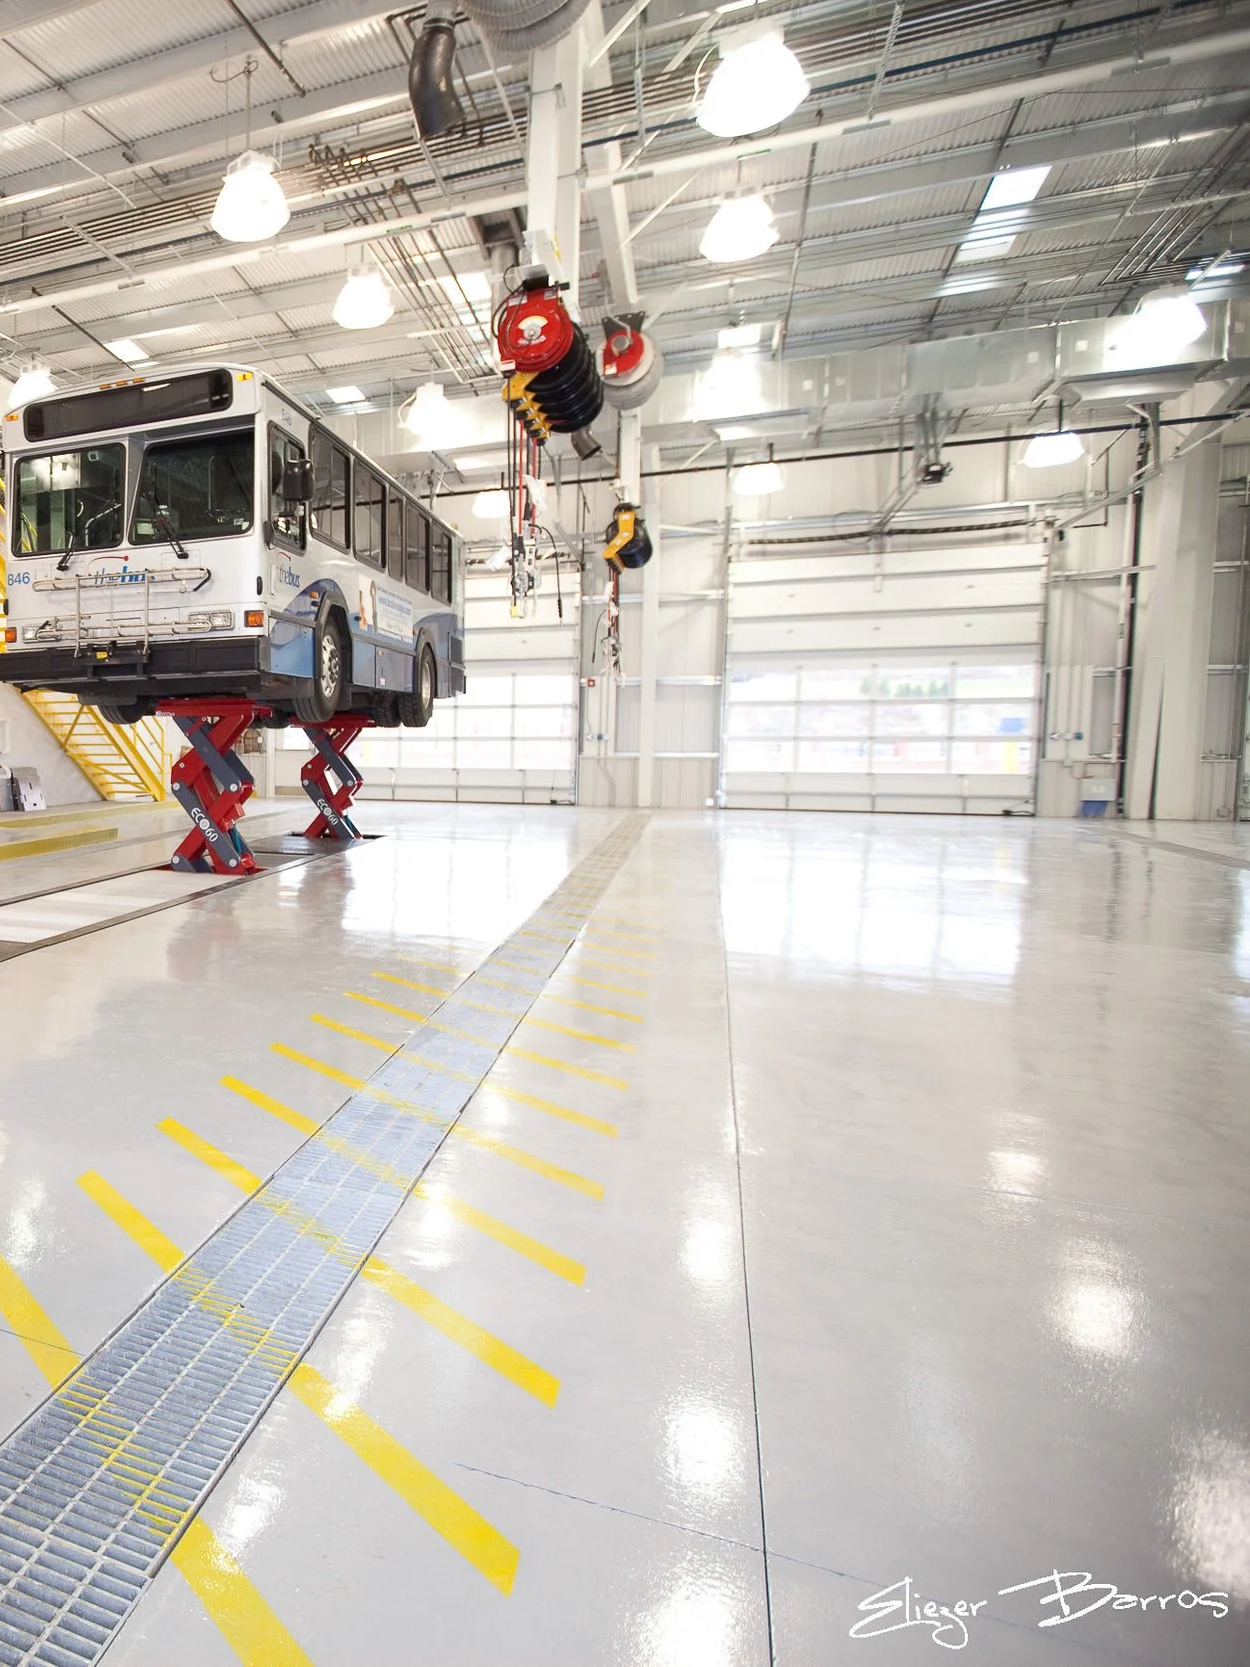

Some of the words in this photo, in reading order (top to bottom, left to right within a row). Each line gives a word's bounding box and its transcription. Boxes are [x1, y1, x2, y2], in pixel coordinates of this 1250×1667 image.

[7, 571, 31, 586] 846
[190, 806, 220, 843] ECO60
[316, 797, 339, 826] ECO60
